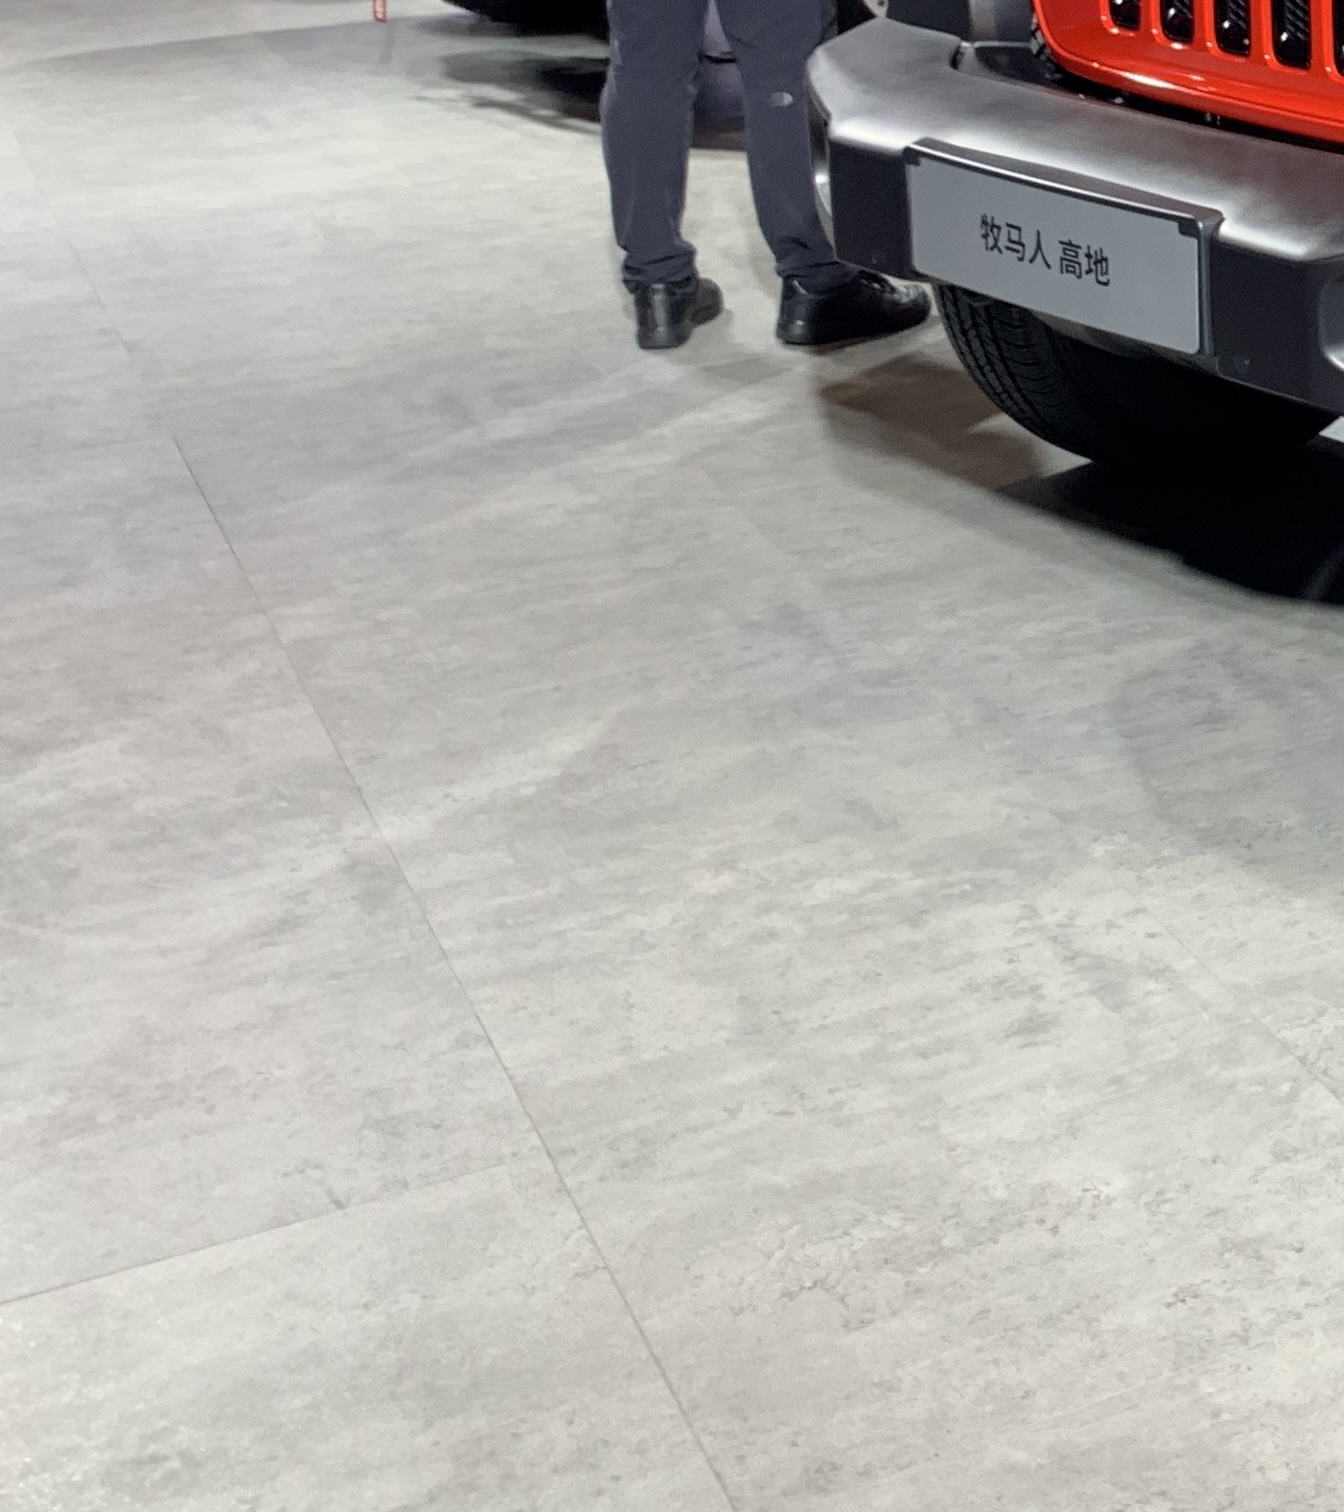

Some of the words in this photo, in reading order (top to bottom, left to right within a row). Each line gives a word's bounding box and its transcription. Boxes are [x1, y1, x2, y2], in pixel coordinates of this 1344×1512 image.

[980, 213, 1051, 270] 牧马人
[1058, 238, 1110, 287] 高地
